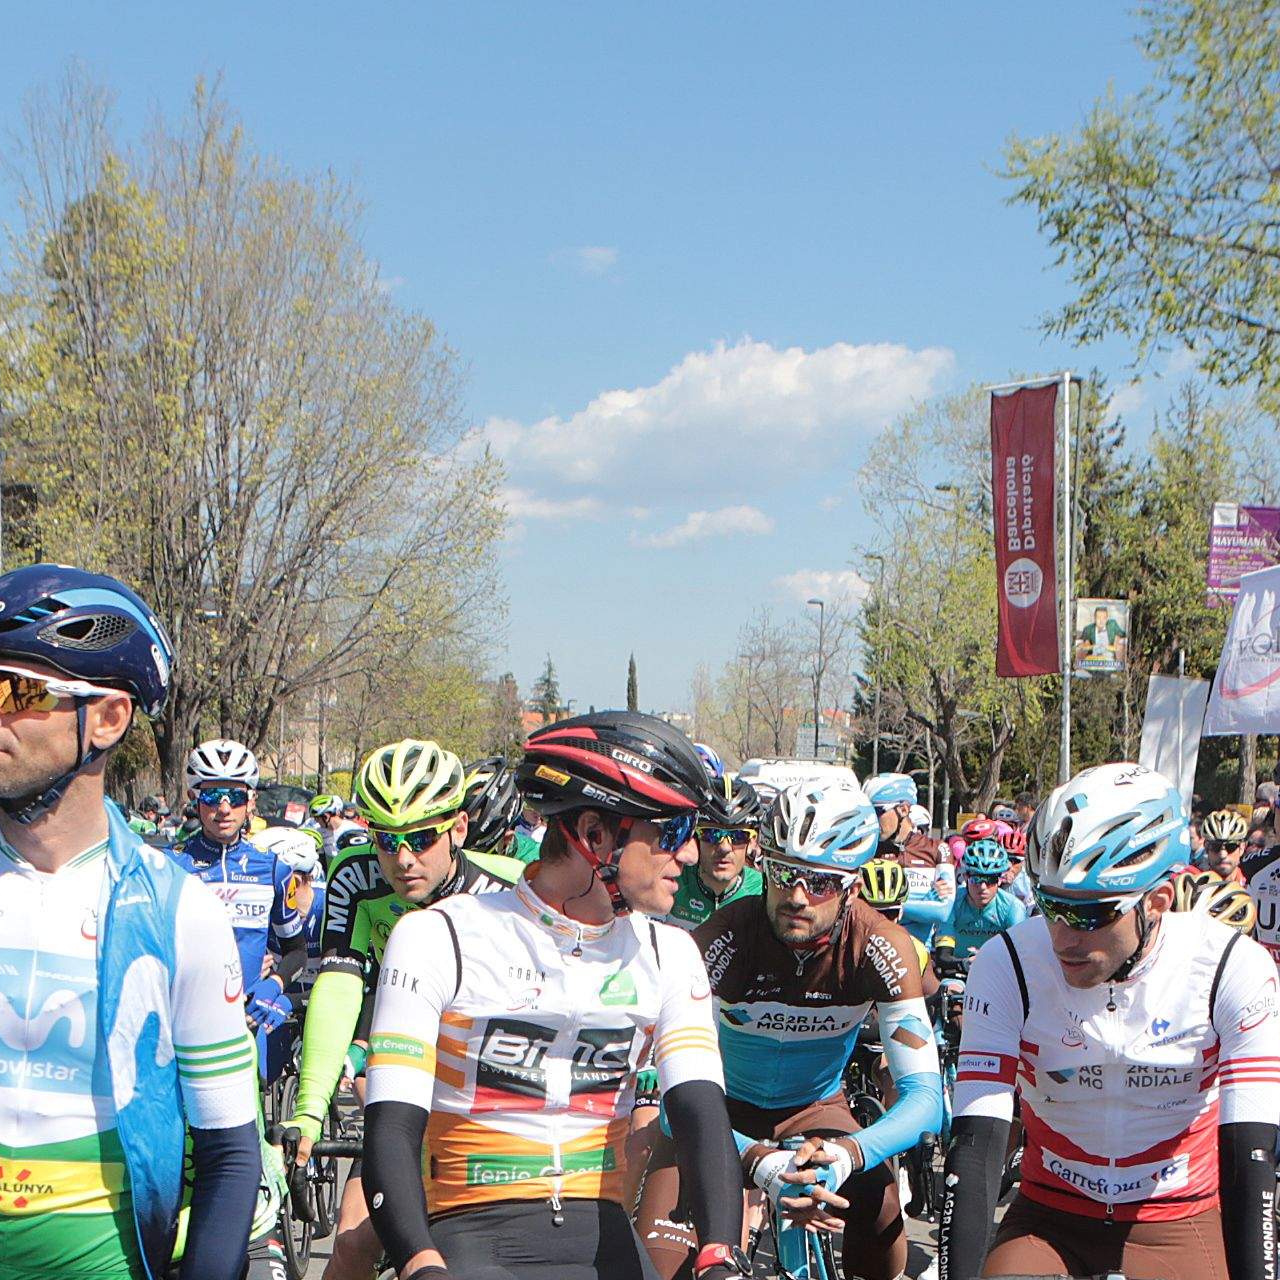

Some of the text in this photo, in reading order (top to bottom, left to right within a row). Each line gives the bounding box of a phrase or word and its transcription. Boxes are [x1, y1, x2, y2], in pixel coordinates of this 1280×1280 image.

[611, 748, 652, 773] GIRO
[581, 784, 620, 806] BMC
[327, 860, 389, 933] MURIA
[235, 904, 266, 917] STEP
[711, 947, 737, 990] MONDIA
[757, 1020, 854, 1033] MONDIALE
[759, 1012, 835, 1024] AG2R LA
[942, 1191, 955, 1226] AG2R
[940, 1226, 951, 1245] LA
[1262, 1190, 1275, 1260] MONDIALE
